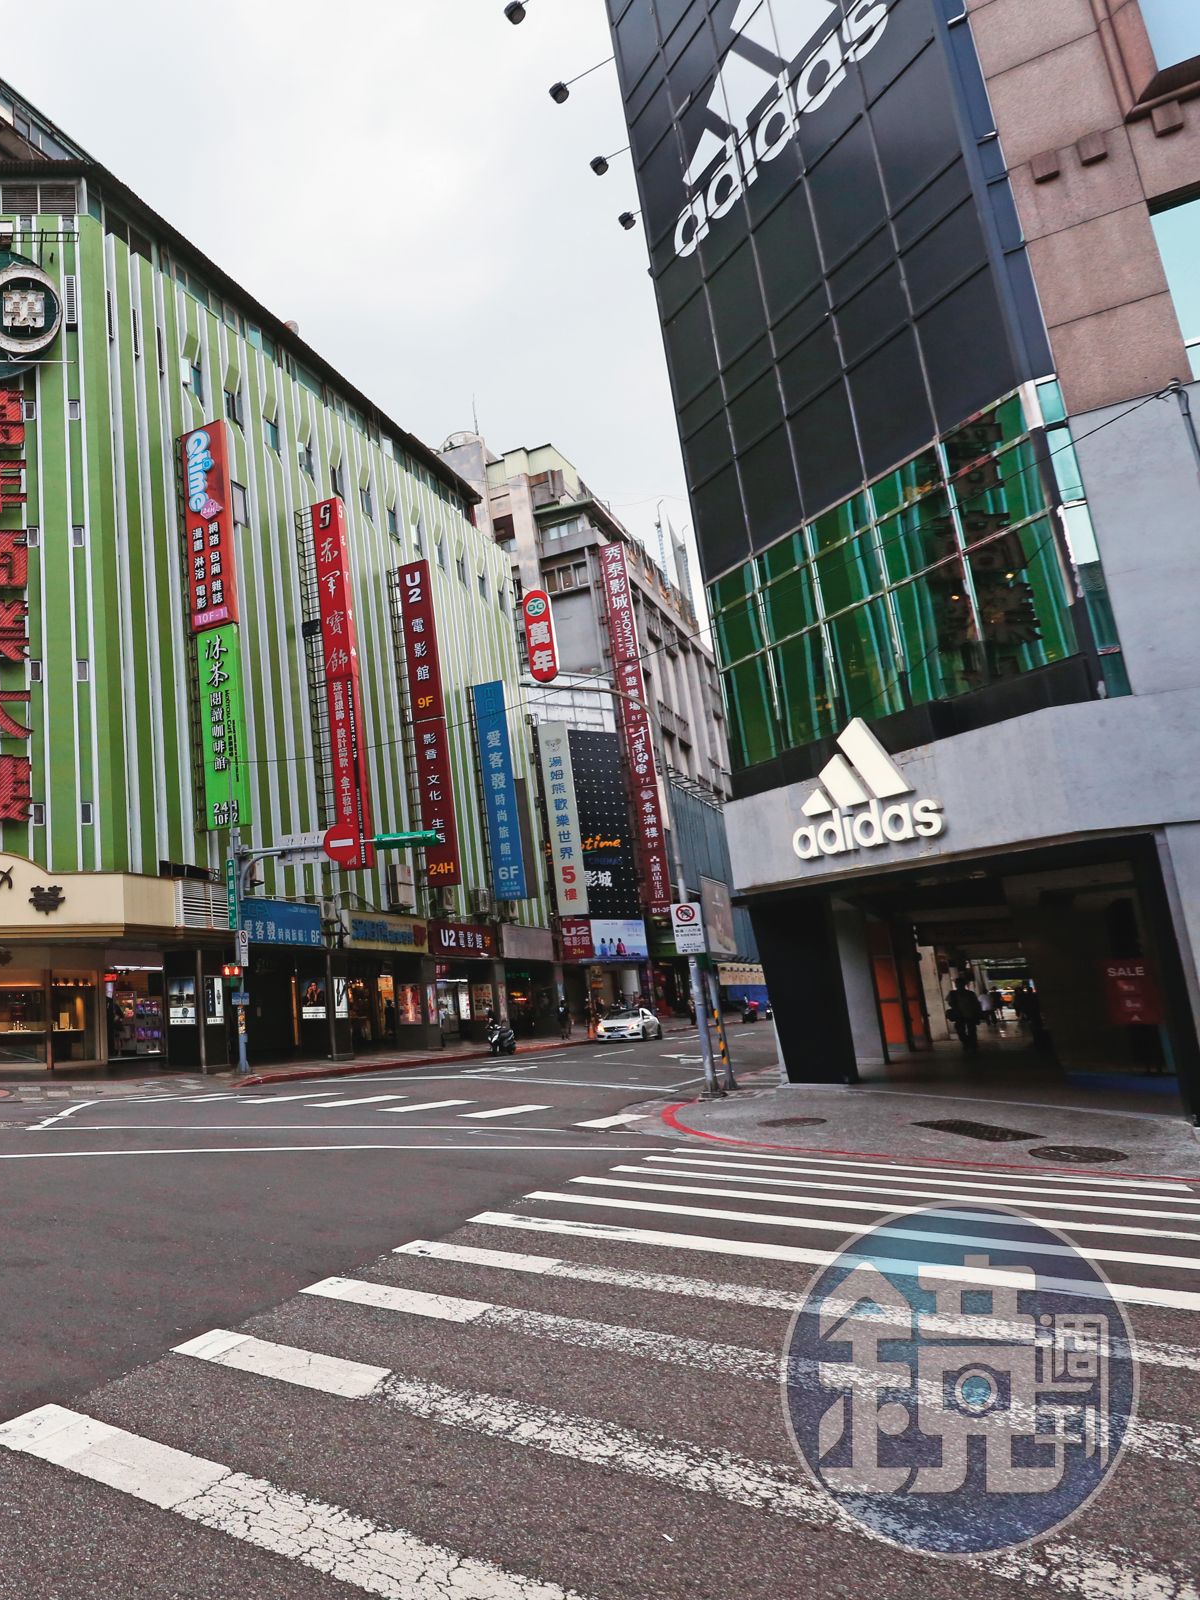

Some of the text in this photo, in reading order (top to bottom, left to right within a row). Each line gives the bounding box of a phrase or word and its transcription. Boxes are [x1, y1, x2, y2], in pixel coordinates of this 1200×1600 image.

[674, 0, 889, 257] adidas
[194, 555, 206, 580] 淋浴
[208, 521, 224, 604] 網路 包廂 雜誌
[405, 571, 422, 603] U2
[604, 545, 629, 610] 秀泰影城
[196, 584, 207, 609] 電影
[197, 609, 226, 624] 10F-1
[528, 621, 554, 672] 萬年
[620, 610, 636, 658] SHOWTIME
[411, 618, 430, 681] 電影館
[417, 696, 434, 709] 9F
[214, 812, 238, 826] 10F2
[549, 756, 574, 860] 湯姆熊歡樂世界
[793, 798, 946, 860] adidas
[429, 862, 454, 875] 24H
[499, 866, 519, 880] 6F
[584, 870, 613, 888] 影城
[650, 862, 664, 899] 誠品生活
[28, 885, 66, 915] 華
[310, 930, 320, 944] 6F
[440, 928, 457, 947] U2
[562, 926, 590, 936] U2
[1106, 966, 1145, 977] SALE
